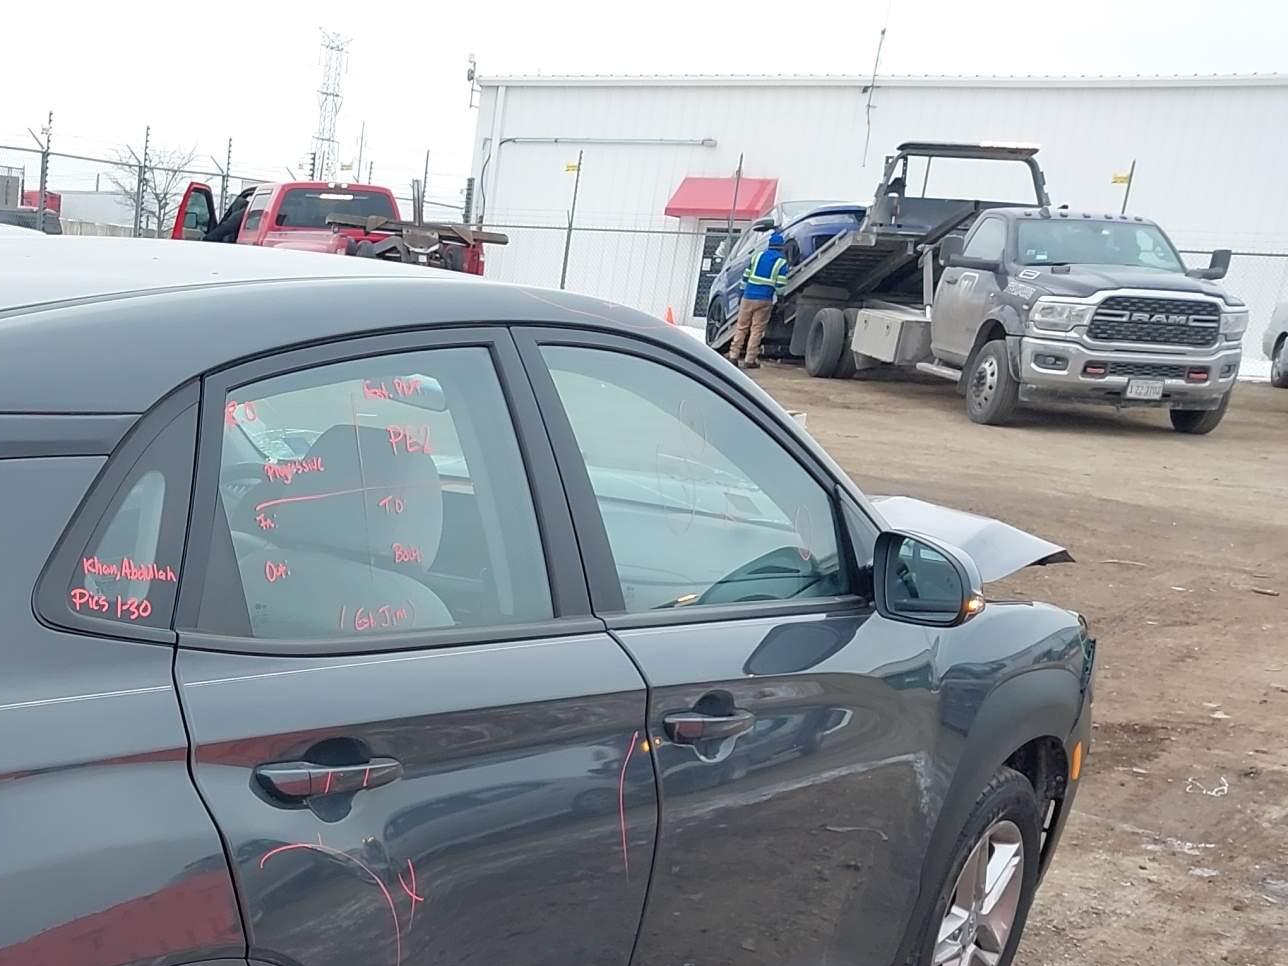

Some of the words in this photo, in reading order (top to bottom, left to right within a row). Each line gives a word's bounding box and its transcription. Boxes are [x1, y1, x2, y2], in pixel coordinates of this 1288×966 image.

[1132, 312, 1188, 325] RAM
[71, 588, 109, 612] Pics
[116, 595, 152, 619] 1-30
